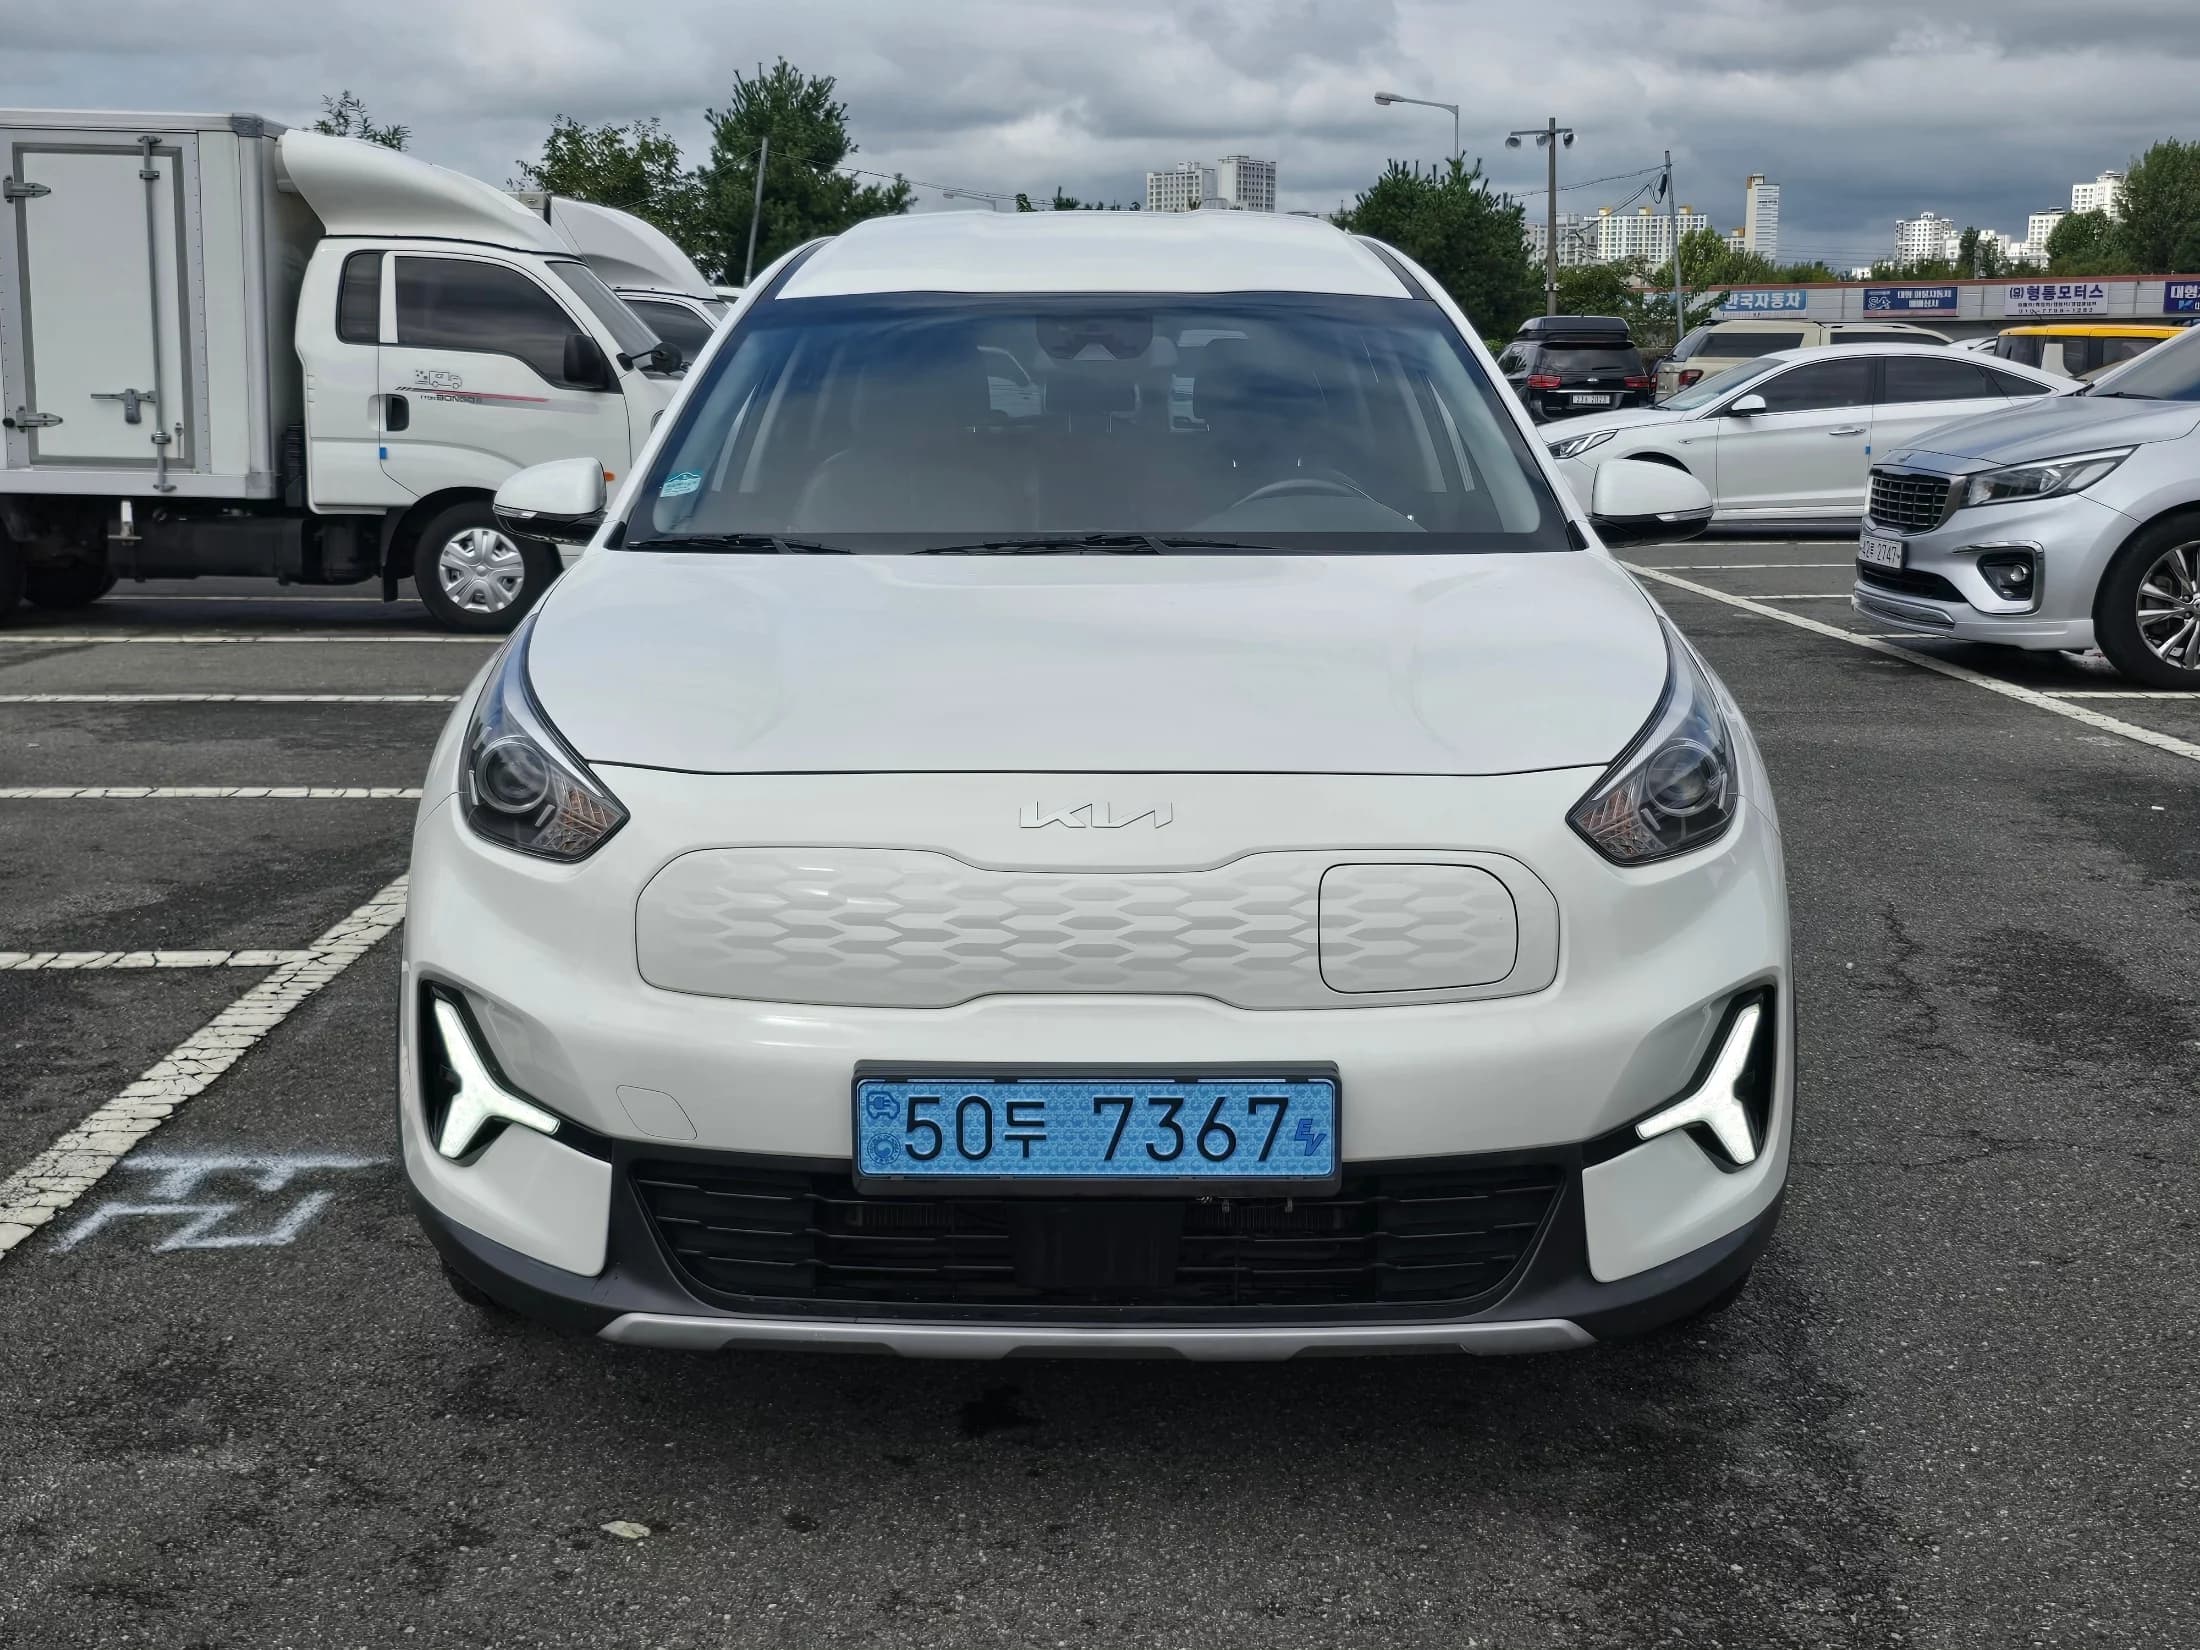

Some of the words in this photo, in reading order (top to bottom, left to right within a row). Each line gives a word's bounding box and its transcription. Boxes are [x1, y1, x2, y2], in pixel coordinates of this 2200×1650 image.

[1877, 543, 1897, 565] 2747
[904, 1094, 1048, 1162] 50두
[1092, 1094, 1290, 1163] 7367
